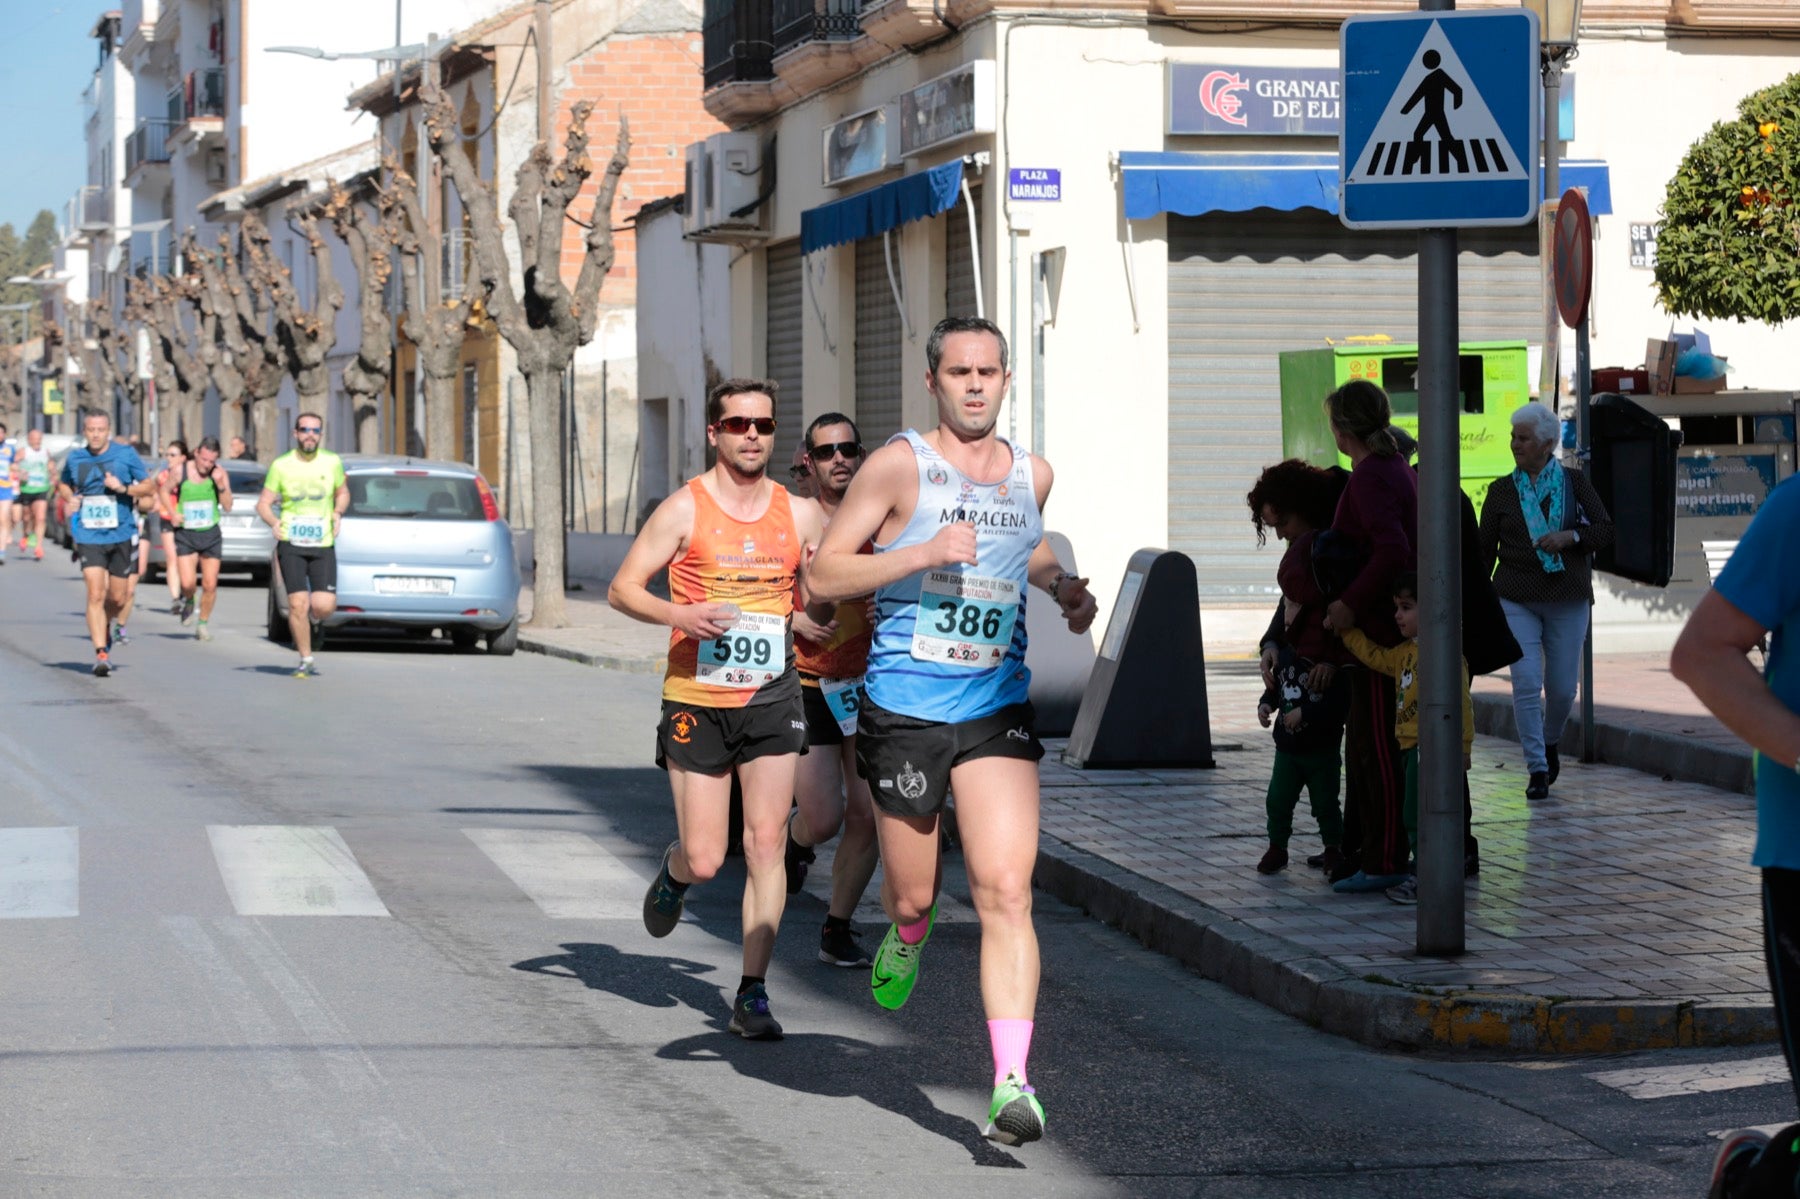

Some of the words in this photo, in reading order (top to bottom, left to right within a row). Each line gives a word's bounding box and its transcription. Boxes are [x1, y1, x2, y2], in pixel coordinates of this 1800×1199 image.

[1272, 100, 1302, 118] DE
[1020, 170, 1048, 180] PLAZA
[1011, 184, 1058, 198] NARANJOS
[1631, 225, 1647, 240] SE
[87, 506, 111, 518] 126
[192, 509, 206, 519] 76
[939, 508, 1028, 529] MARACENA
[291, 525, 323, 538] 1093
[949, 575, 966, 585] GRAN
[967, 577, 989, 588] PREMIO
[934, 601, 1003, 639] 386
[713, 635, 771, 665] 599
[840, 686, 864, 713] 5
